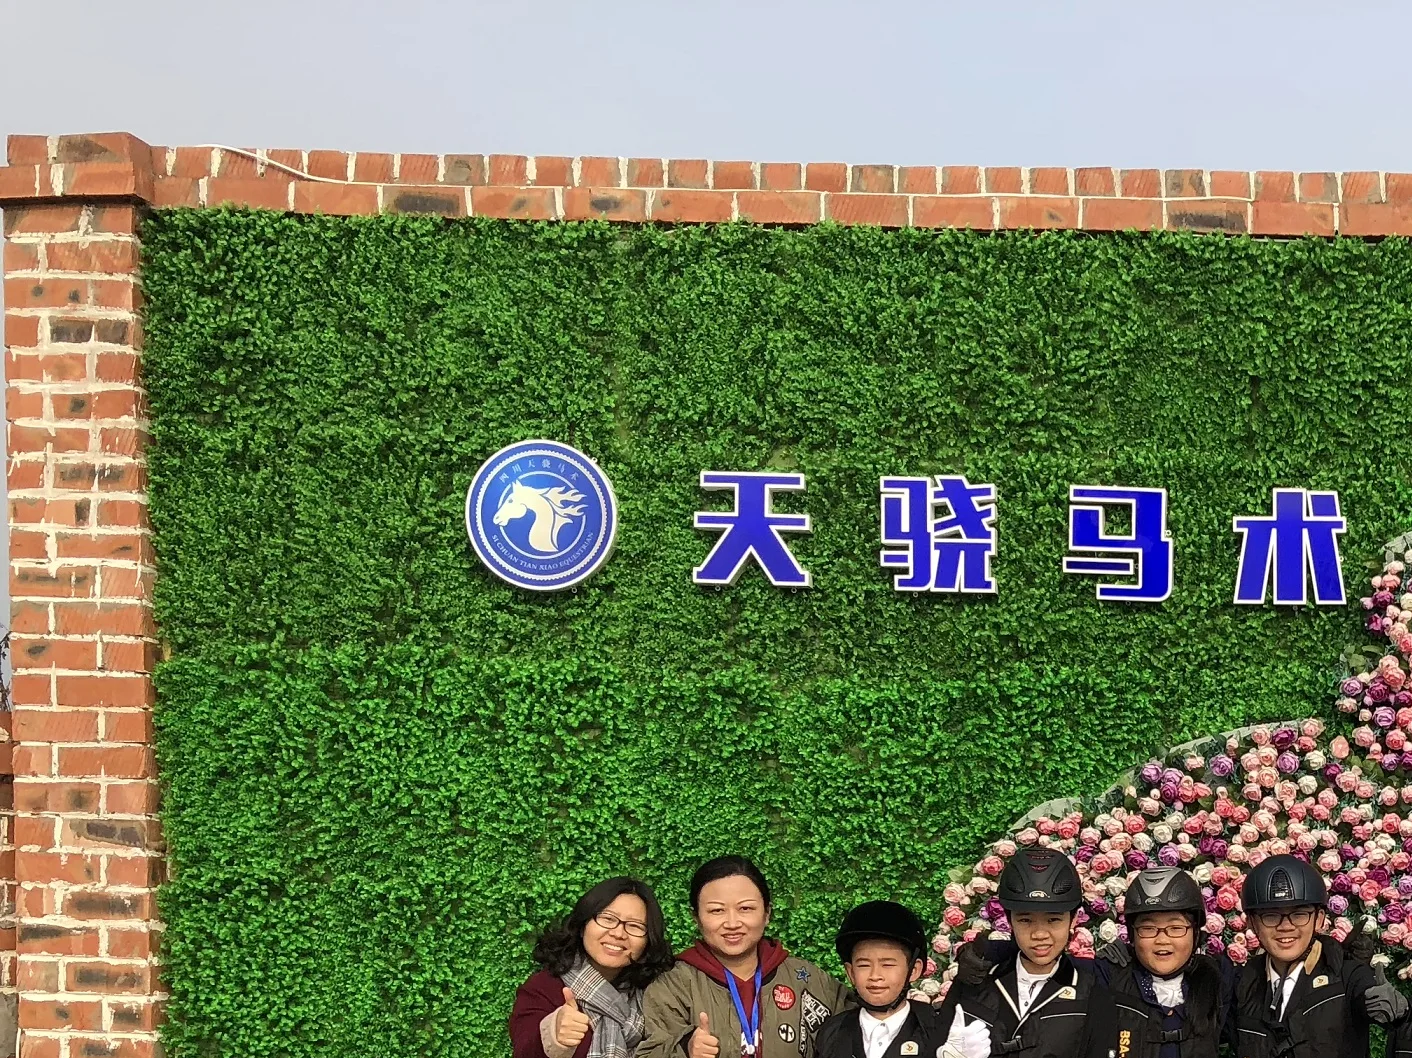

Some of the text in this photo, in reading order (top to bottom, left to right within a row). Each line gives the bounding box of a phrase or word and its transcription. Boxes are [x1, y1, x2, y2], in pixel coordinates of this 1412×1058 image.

[496, 542, 518, 563] CHUAN
[520, 560, 537, 569] TIAN
[693, 471, 1347, 605] 天骁马术
